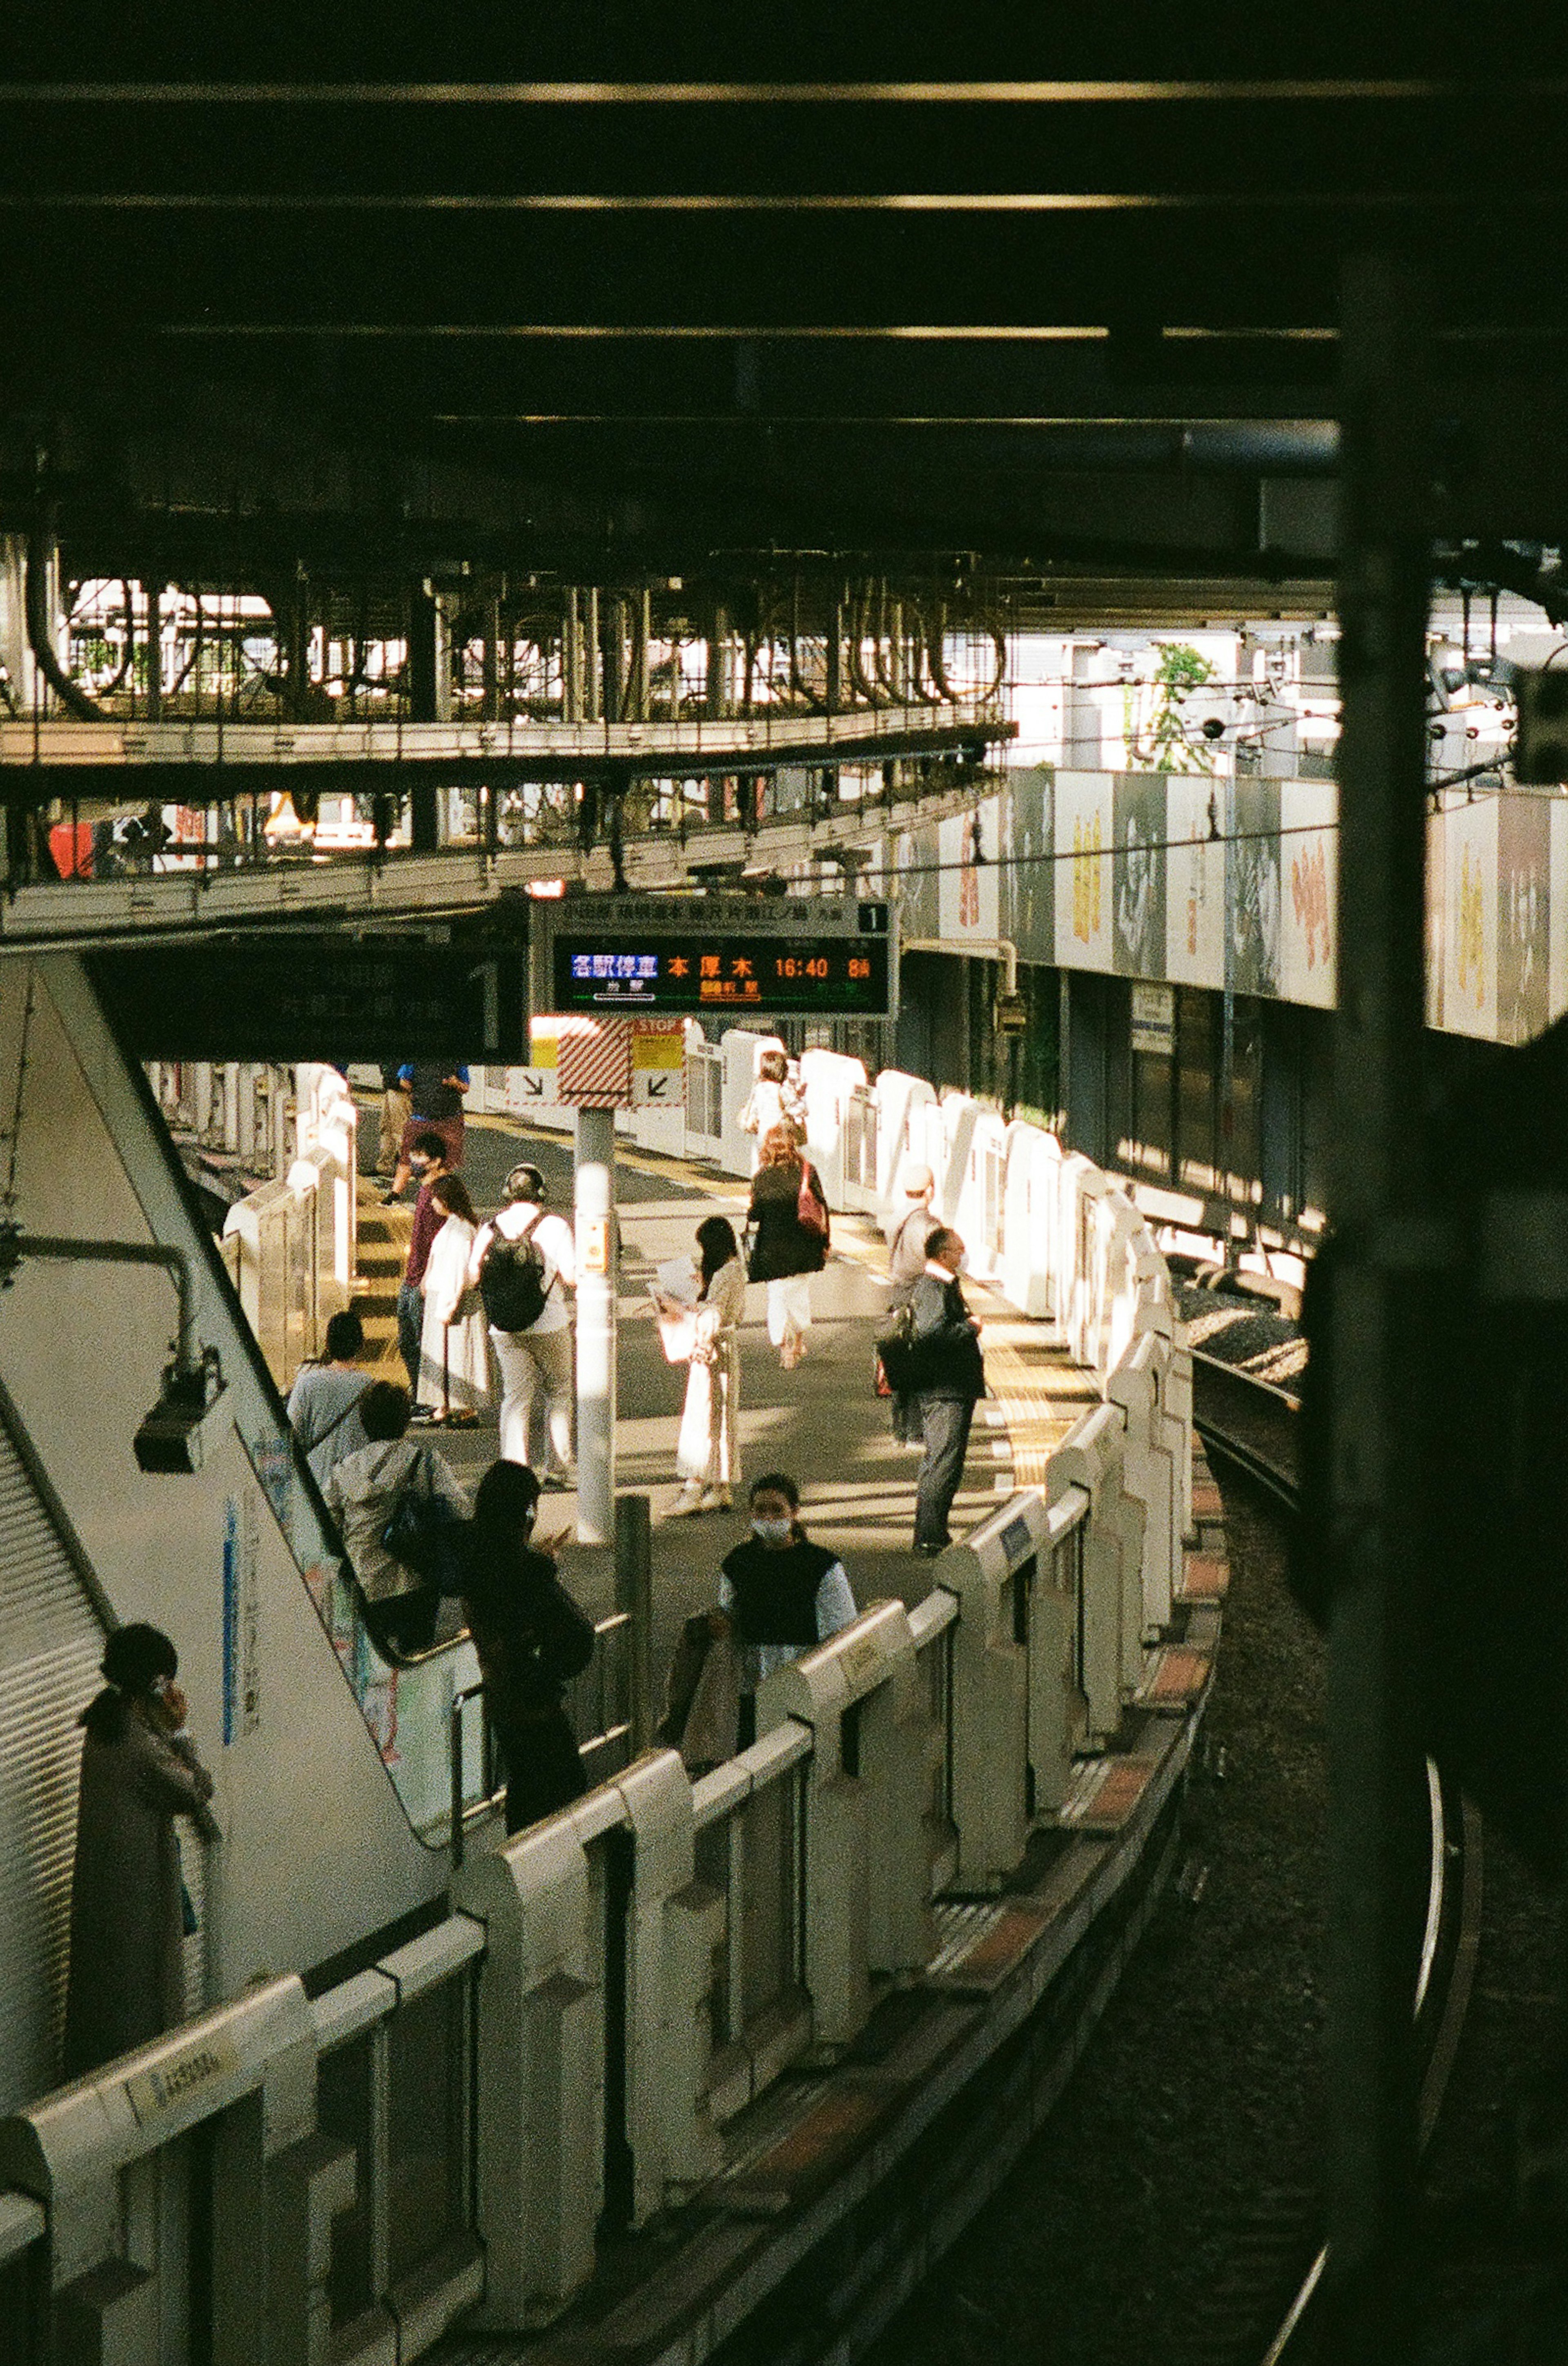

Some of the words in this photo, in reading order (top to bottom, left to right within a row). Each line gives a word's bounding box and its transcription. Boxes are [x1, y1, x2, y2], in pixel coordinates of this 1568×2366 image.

[869, 906, 877, 930] 1
[572, 954, 658, 978] 各駅停車
[776, 958, 828, 978] 16:40
[639, 1019, 676, 1032] STOP
